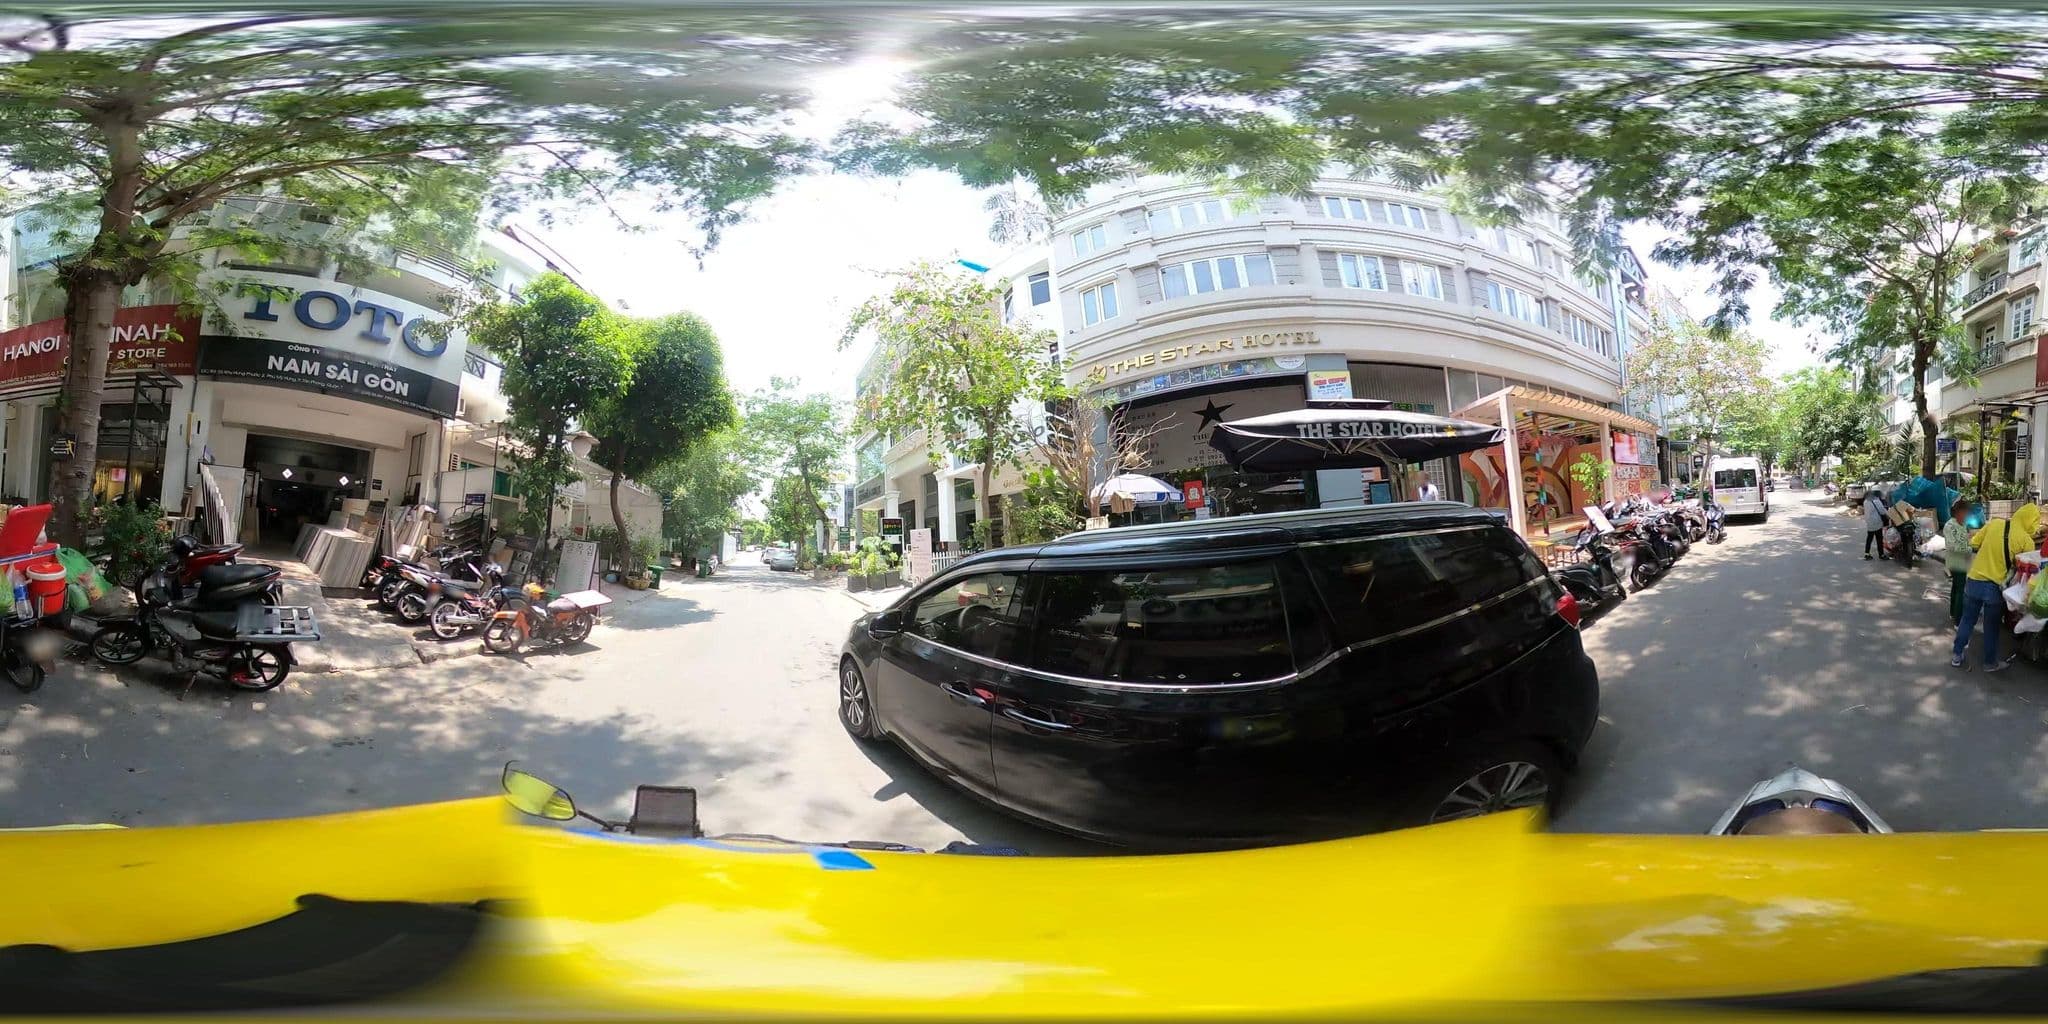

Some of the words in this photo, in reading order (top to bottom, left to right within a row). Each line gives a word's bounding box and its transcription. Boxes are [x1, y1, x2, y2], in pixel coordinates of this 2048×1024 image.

[238, 282, 448, 359] TOTO
[3, 335, 61, 362] HANOI
[116, 347, 167, 360] STORE
[1110, 352, 1156, 375] THE
[1160, 339, 1234, 362] STAR
[1241, 331, 1320, 349] HOTEL
[267, 355, 321, 377] NAM
[325, 361, 359, 384] SÀI
[364, 372, 409, 397] GÒN
[1296, 422, 1333, 438] THE
[1339, 421, 1385, 438] STAR
[1389, 421, 1438, 437] HOTEL
